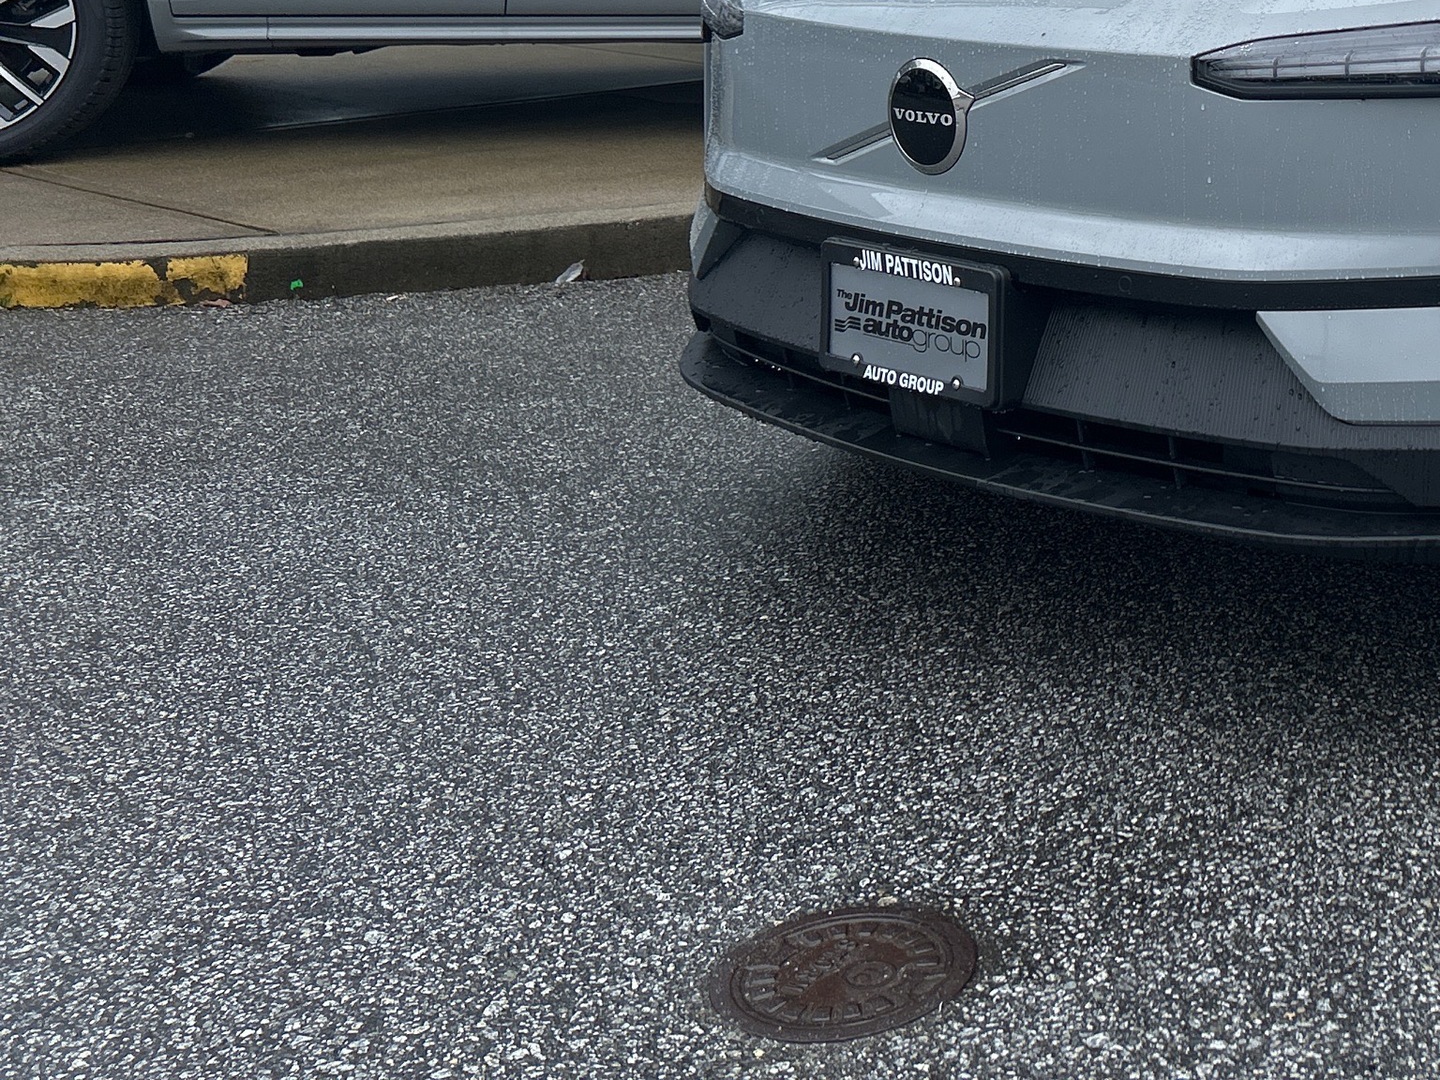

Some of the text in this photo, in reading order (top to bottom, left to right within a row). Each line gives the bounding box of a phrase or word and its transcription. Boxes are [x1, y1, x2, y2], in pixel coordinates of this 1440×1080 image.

[893, 107, 953, 126] VOLVO
[860, 249, 953, 286] JIM PATTISON
[836, 288, 853, 301] The
[863, 365, 945, 396] AUTO GROUP
